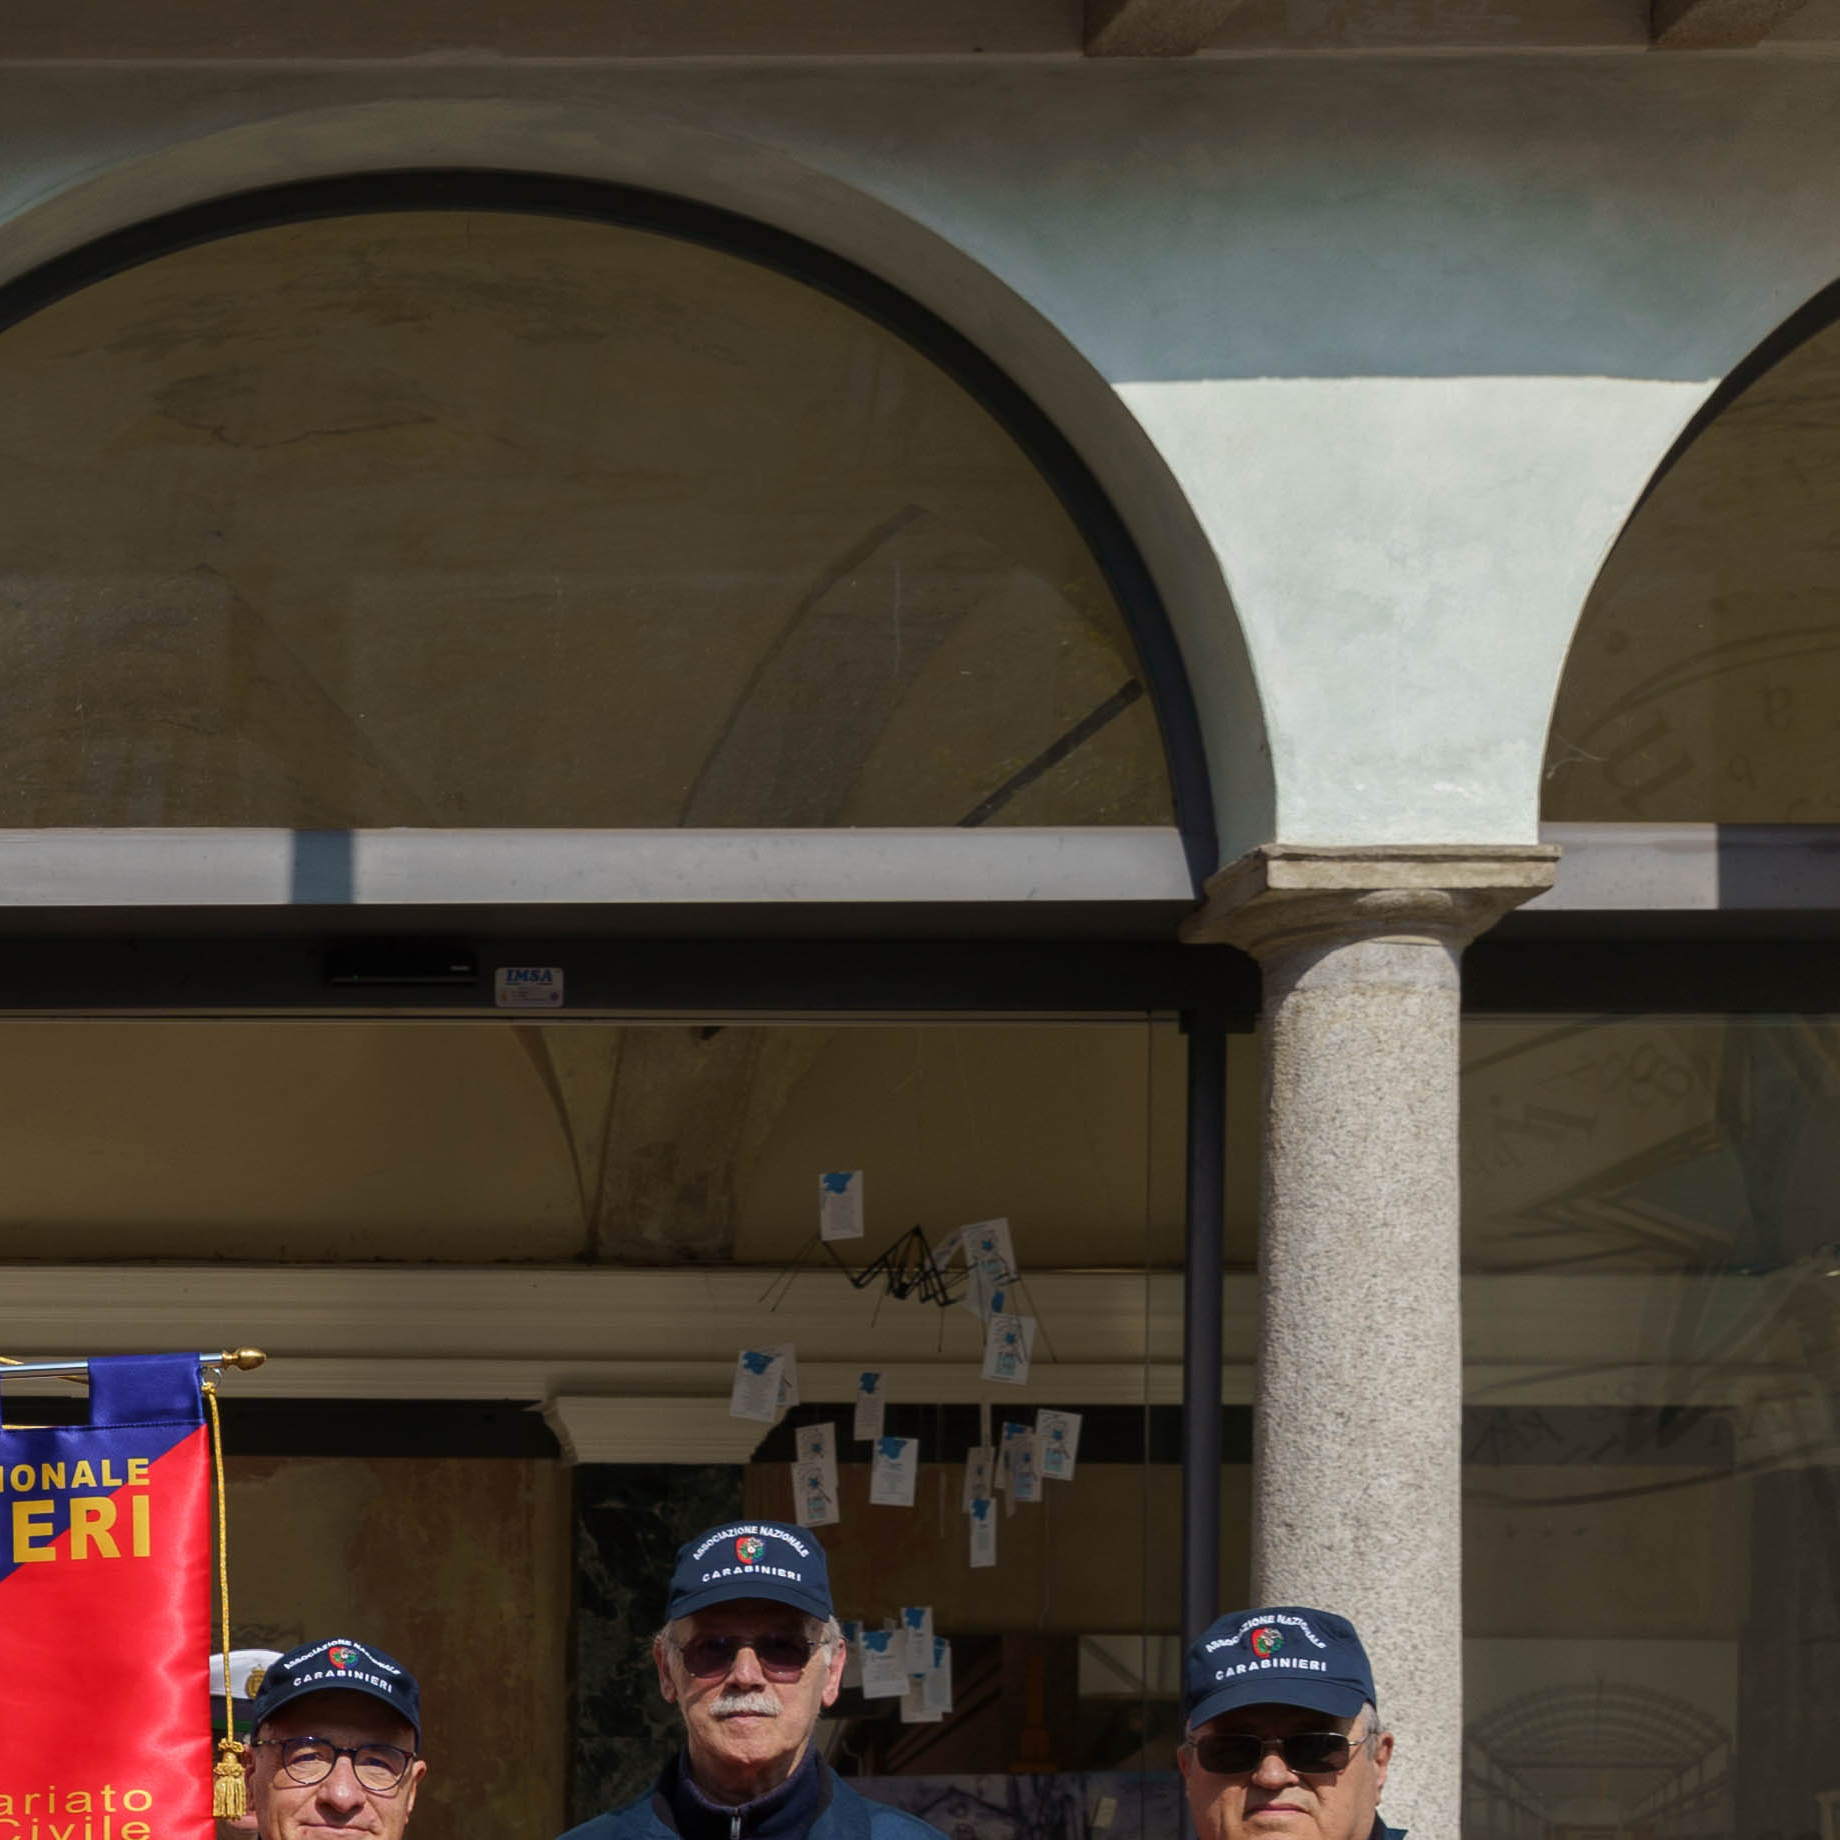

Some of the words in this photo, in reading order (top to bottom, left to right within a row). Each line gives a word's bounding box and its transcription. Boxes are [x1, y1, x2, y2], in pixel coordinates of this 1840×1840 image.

[693, 1525, 758, 1560] ASSOCIAZIONE
[759, 1525, 810, 1558] NAZIONALE
[702, 1565, 802, 1582] CARABINIERI
[1215, 1658, 1327, 1680] CARABINIERI
[293, 1669, 393, 1693] CARABINIERI
